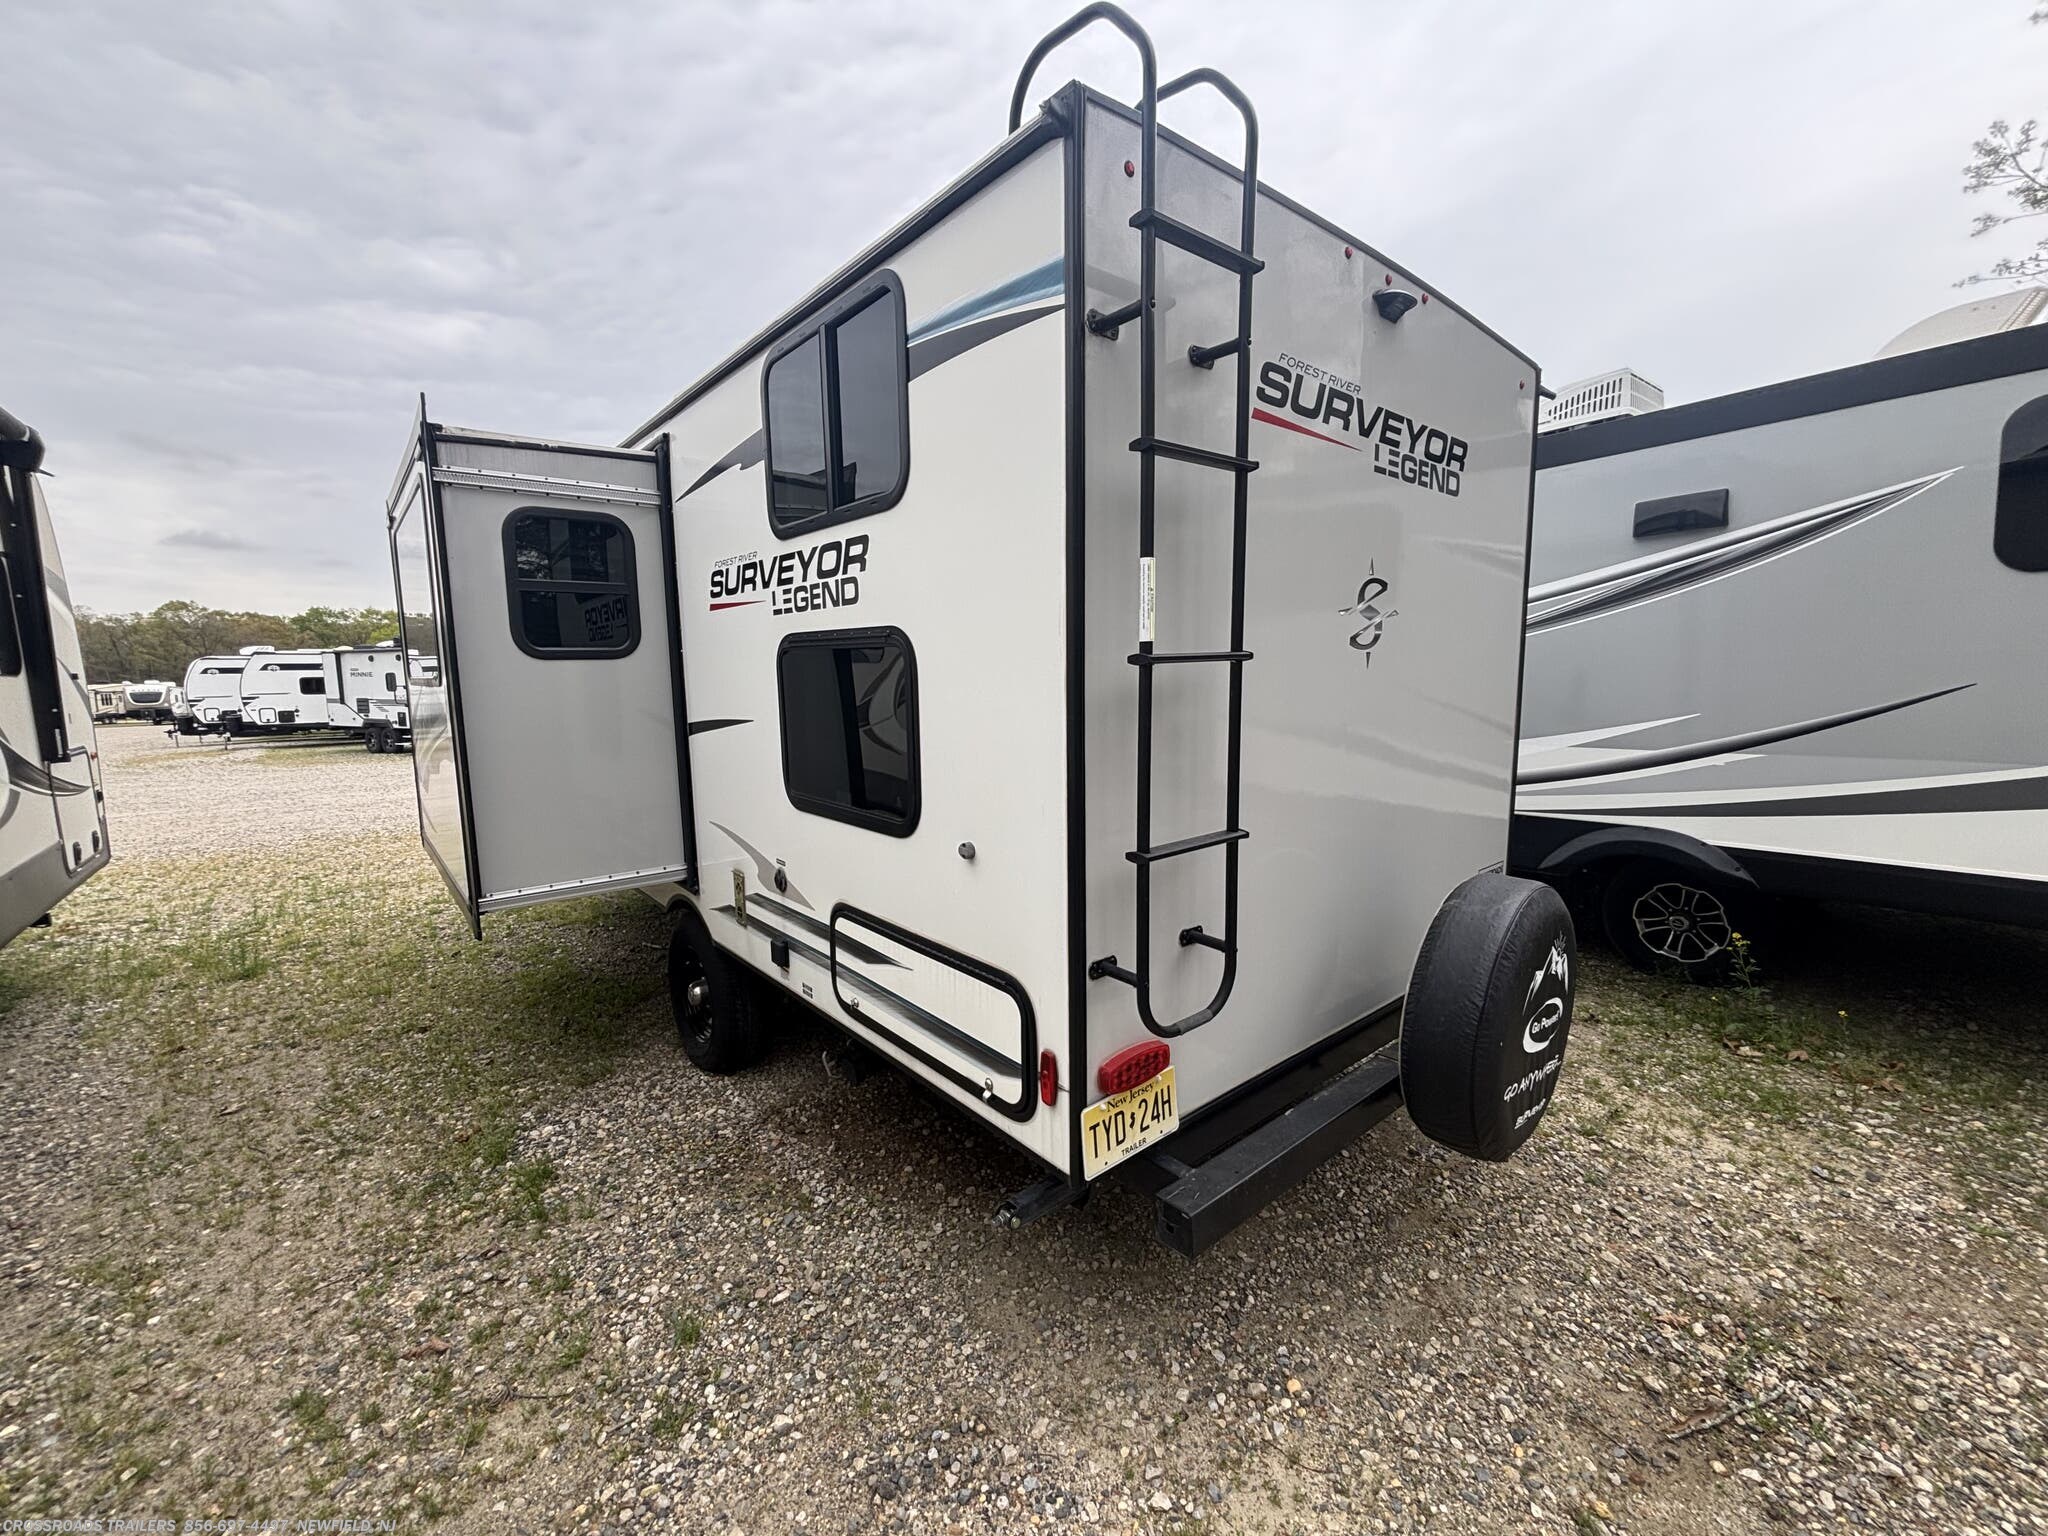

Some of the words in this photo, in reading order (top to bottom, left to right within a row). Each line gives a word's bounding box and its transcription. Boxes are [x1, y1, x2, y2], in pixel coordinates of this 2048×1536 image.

[1278, 353, 1328, 380] FOREST
[1328, 375, 1361, 395] RIVER
[1256, 361, 1468, 472] SURVEYOR
[1374, 443, 1460, 497] LEGEND
[710, 534, 870, 598] SURVEYOR
[714, 557, 738, 569] FOREST
[739, 550, 758, 563] RIVER
[772, 576, 859, 615] LEGEND
[1107, 1095, 1128, 1112] New
[1129, 1083, 1154, 1103] Jersey
[1503, 1082, 1519, 1103] GO
[1121, 1137, 1147, 1156] TRAILER
